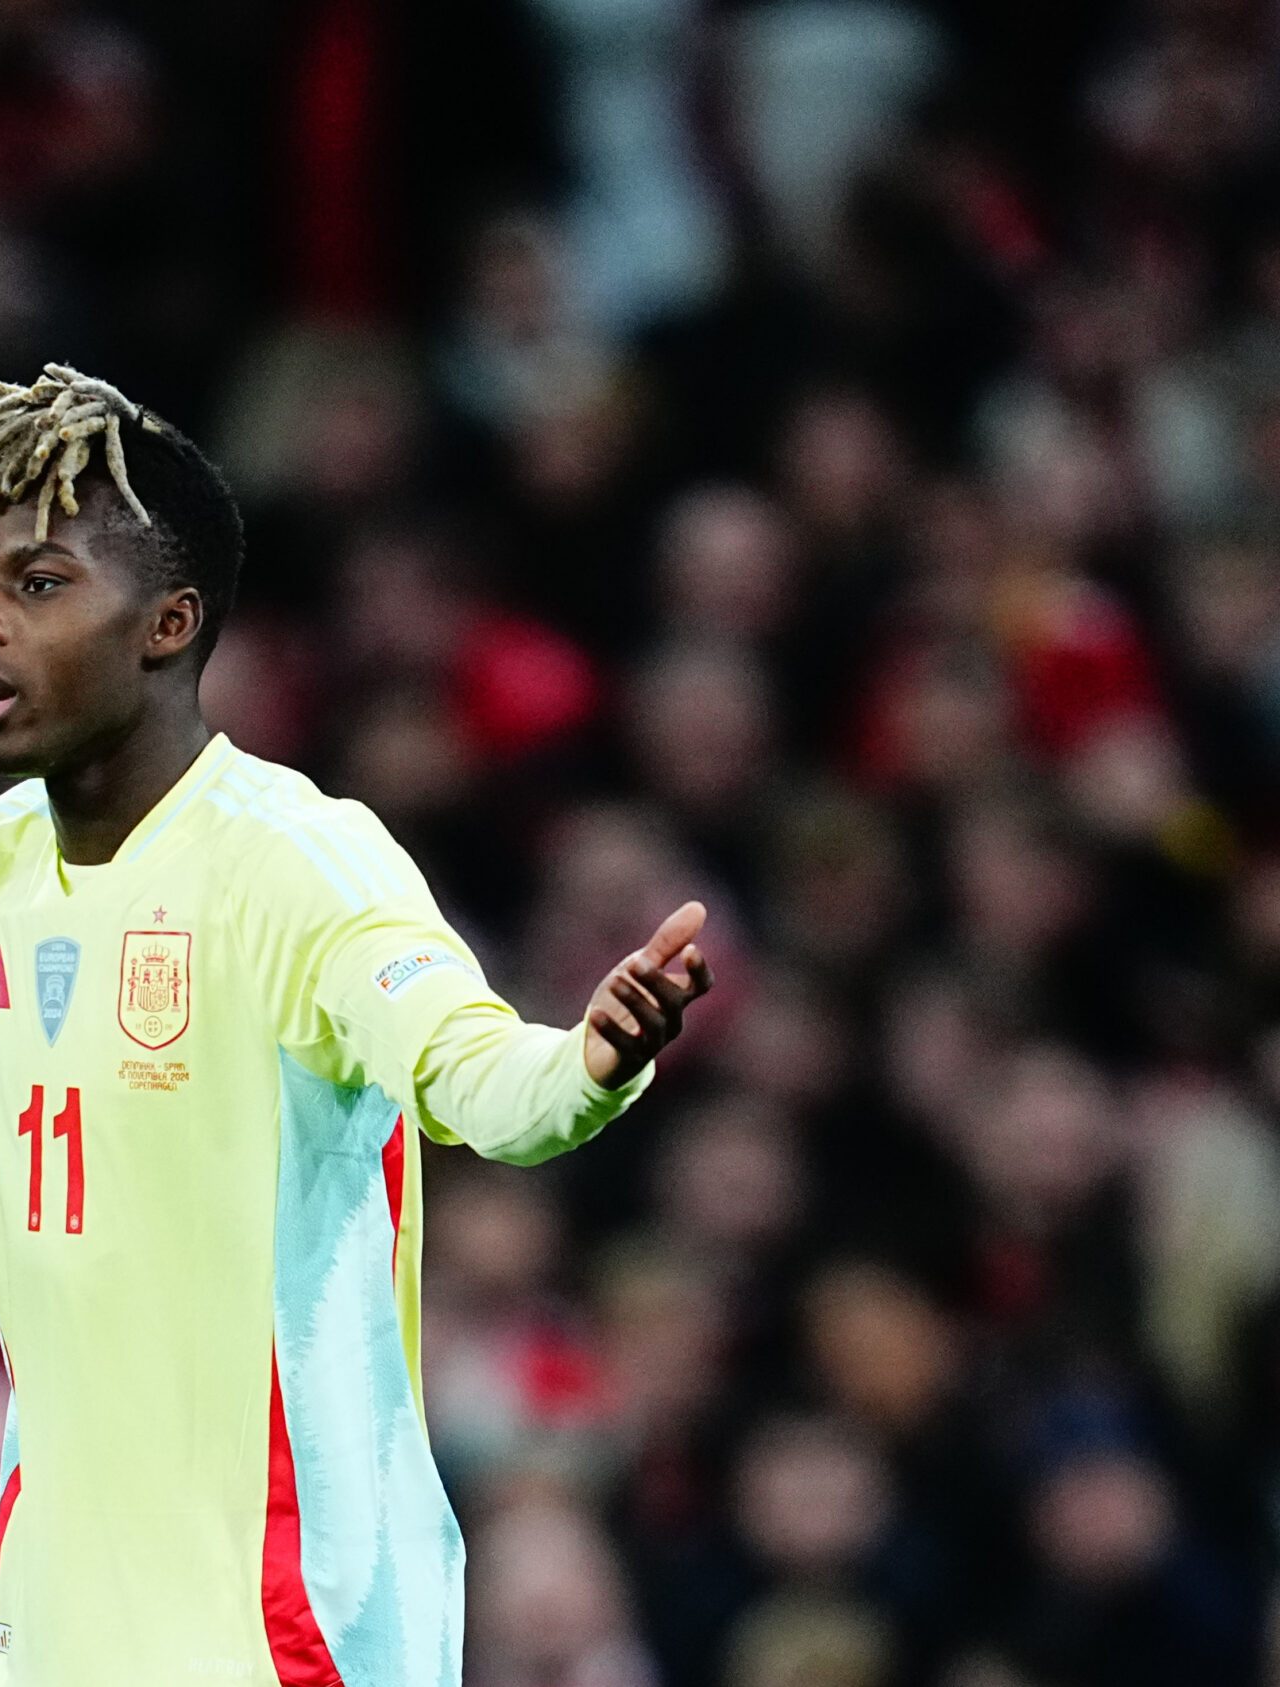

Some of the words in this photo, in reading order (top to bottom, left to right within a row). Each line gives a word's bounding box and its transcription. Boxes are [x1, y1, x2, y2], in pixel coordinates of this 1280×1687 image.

[39, 952, 76, 963] EUROPEAN
[375, 961, 399, 982] UEFA
[128, 1071, 167, 1081] NOVEMBER
[170, 1072, 190, 1081] 2024
[129, 1081, 178, 1091] COPENHAGEN
[18, 1084, 84, 1235] 11
